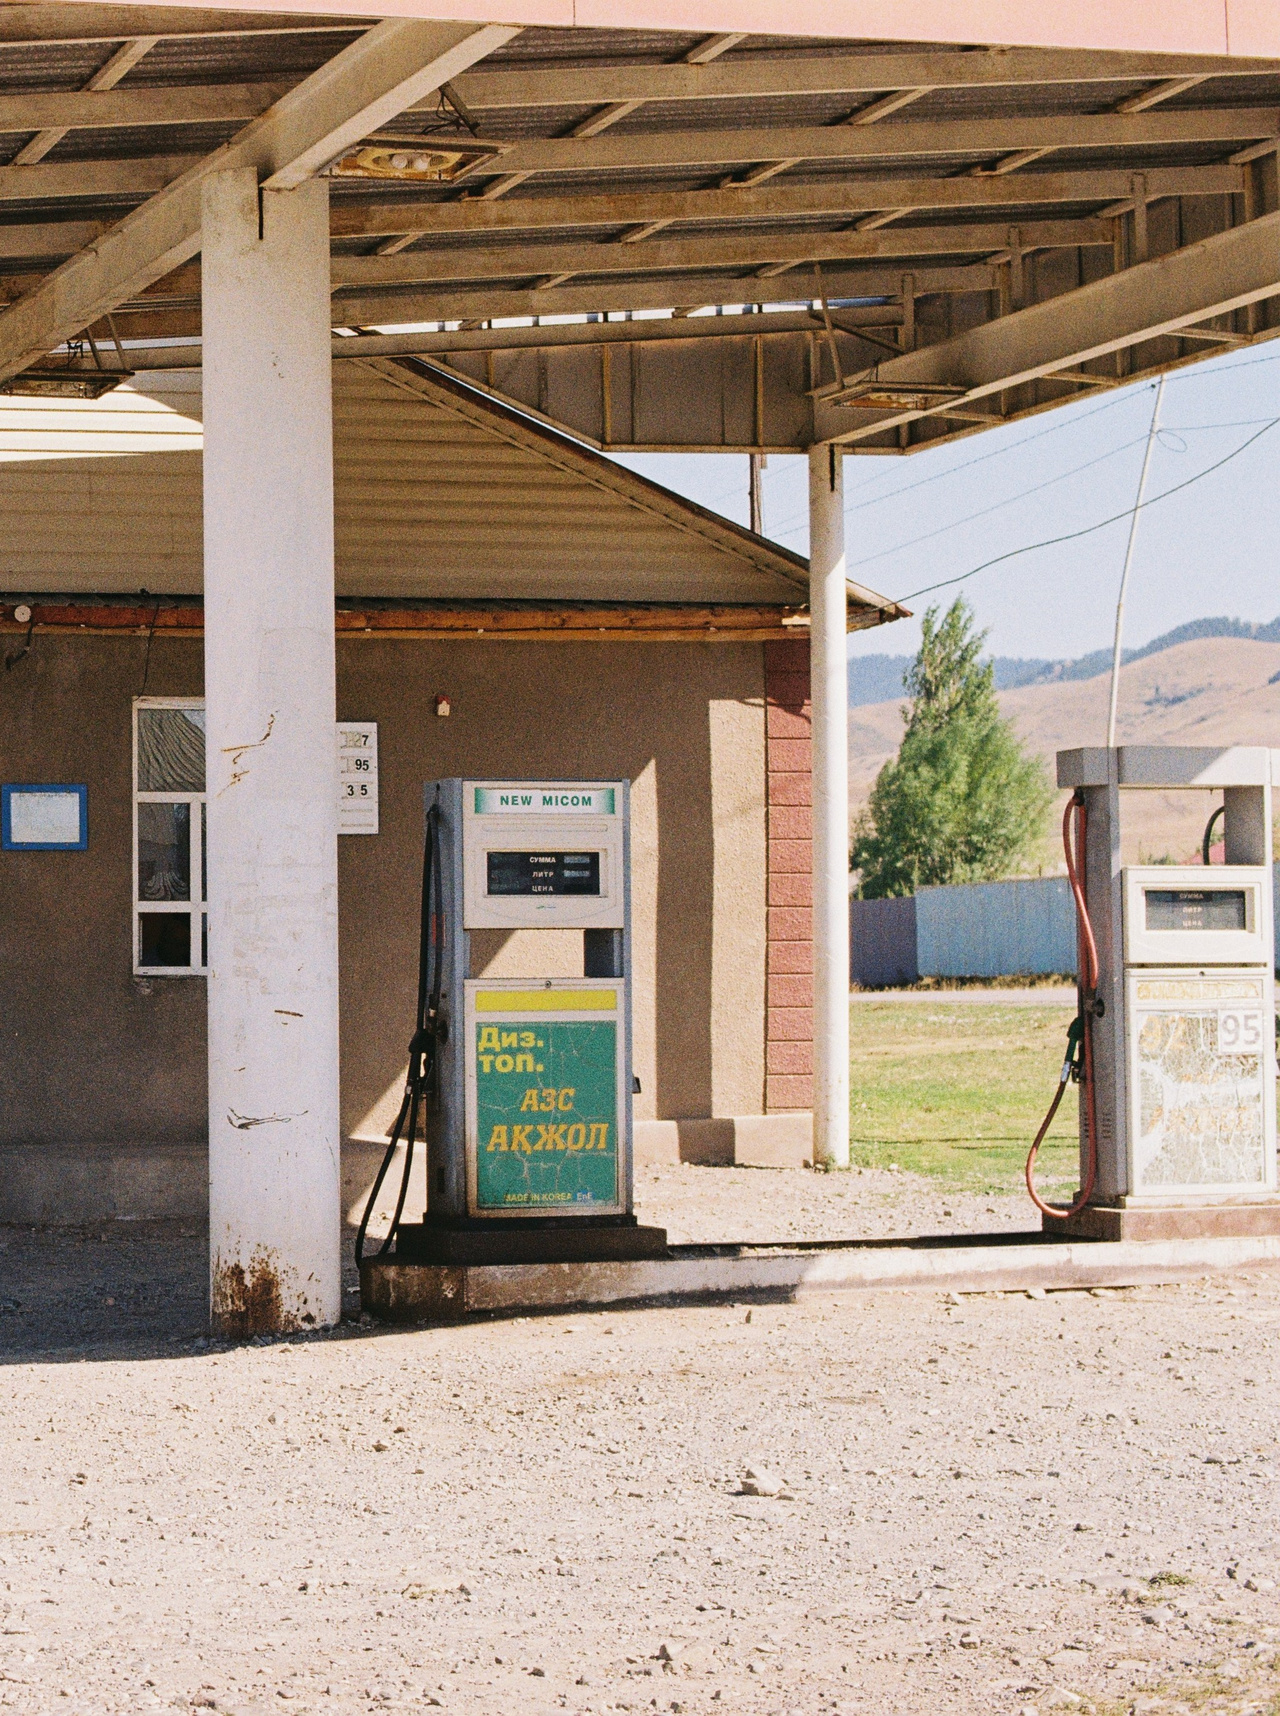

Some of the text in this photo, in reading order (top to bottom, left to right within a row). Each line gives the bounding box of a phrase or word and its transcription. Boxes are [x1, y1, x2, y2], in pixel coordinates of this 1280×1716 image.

[354, 759, 370, 772] 95
[500, 795, 592, 806] NEW MICOM
[478, 1027, 544, 1052] Диз.
[1221, 1014, 1260, 1046] 95
[478, 1054, 544, 1073] топ.
[520, 1088, 576, 1112] АЗС
[504, 1193, 529, 1202] MADE
[531, 1193, 540, 1201] IN
[541, 1192, 572, 1201] KOREA
